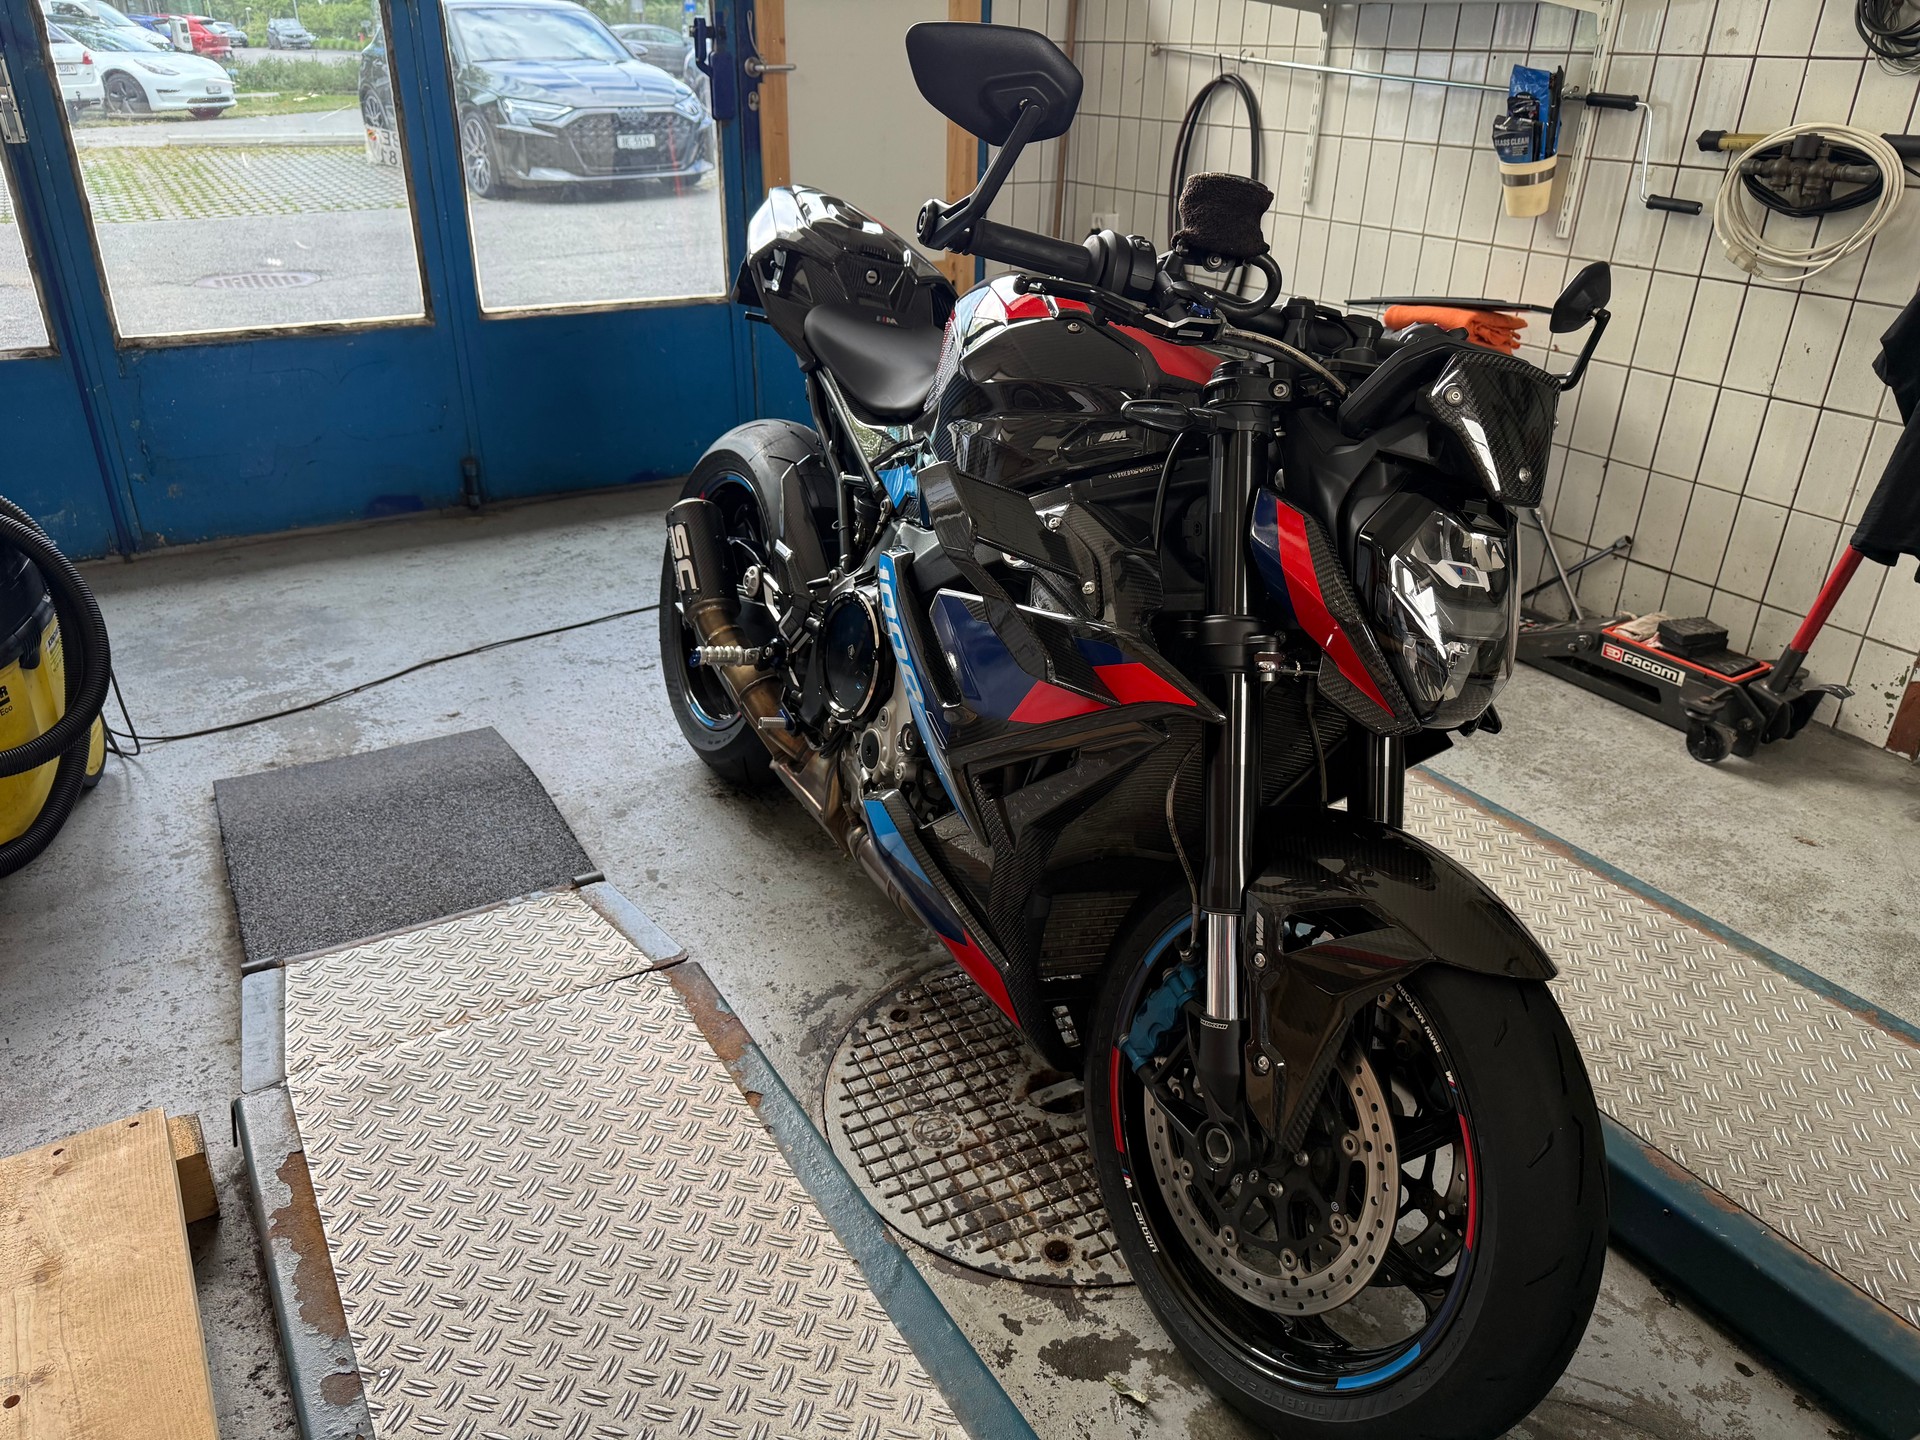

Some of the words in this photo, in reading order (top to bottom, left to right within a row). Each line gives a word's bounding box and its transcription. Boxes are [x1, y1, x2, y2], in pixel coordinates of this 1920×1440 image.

[1511, 136, 1530, 145] CLEAN
[668, 523, 698, 592] SC
[1623, 653, 1678, 682] FACOM
[0, 704, 13, 716] Eco
[1424, 1025, 1441, 1053] BMW
[1131, 1202, 1160, 1253] Carbon
